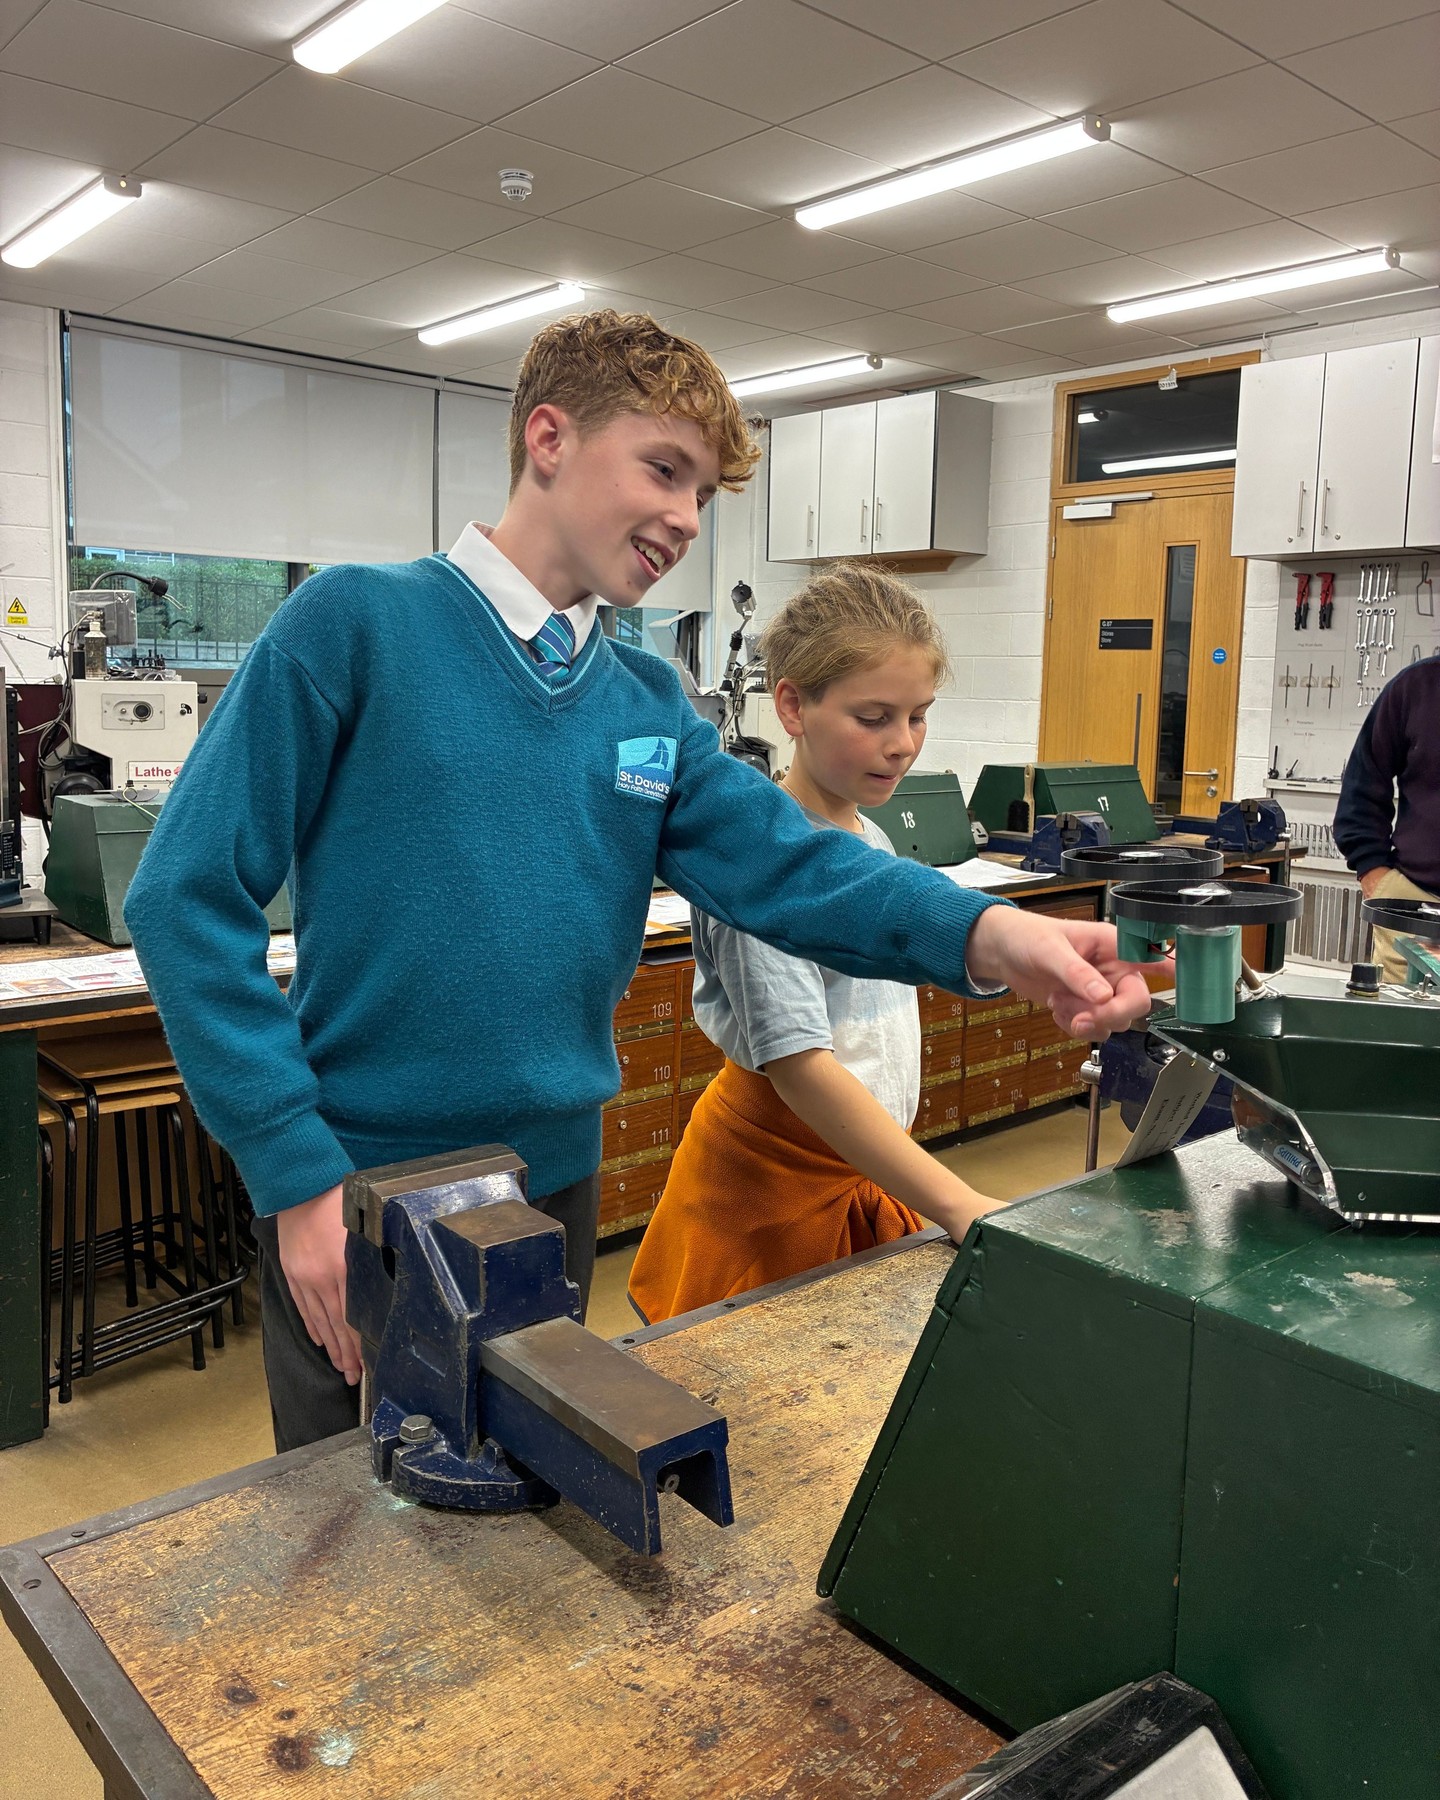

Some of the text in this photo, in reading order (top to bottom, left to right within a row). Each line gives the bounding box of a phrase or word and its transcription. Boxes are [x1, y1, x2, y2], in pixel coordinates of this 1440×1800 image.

[135, 766, 172, 777] Lathe
[618, 781, 631, 790] Holy
[635, 775, 670, 795] David's
[1097, 796, 1109, 811] 17
[901, 811, 915, 829] 18
[652, 1002, 672, 1018] 109
[951, 1003, 962, 1016] 98
[1013, 1039, 1026, 1052] 103
[950, 1055, 961, 1068] 99
[653, 1065, 670, 1082] 110
[1072, 1071, 1080, 1083] 10
[1010, 1088, 1023, 1101] 104
[945, 1107, 959, 1121] 100
[651, 1127, 669, 1145] 111
[1278, 1147, 1302, 1168] PHILIPS
[651, 1191, 665, 1208] 11
